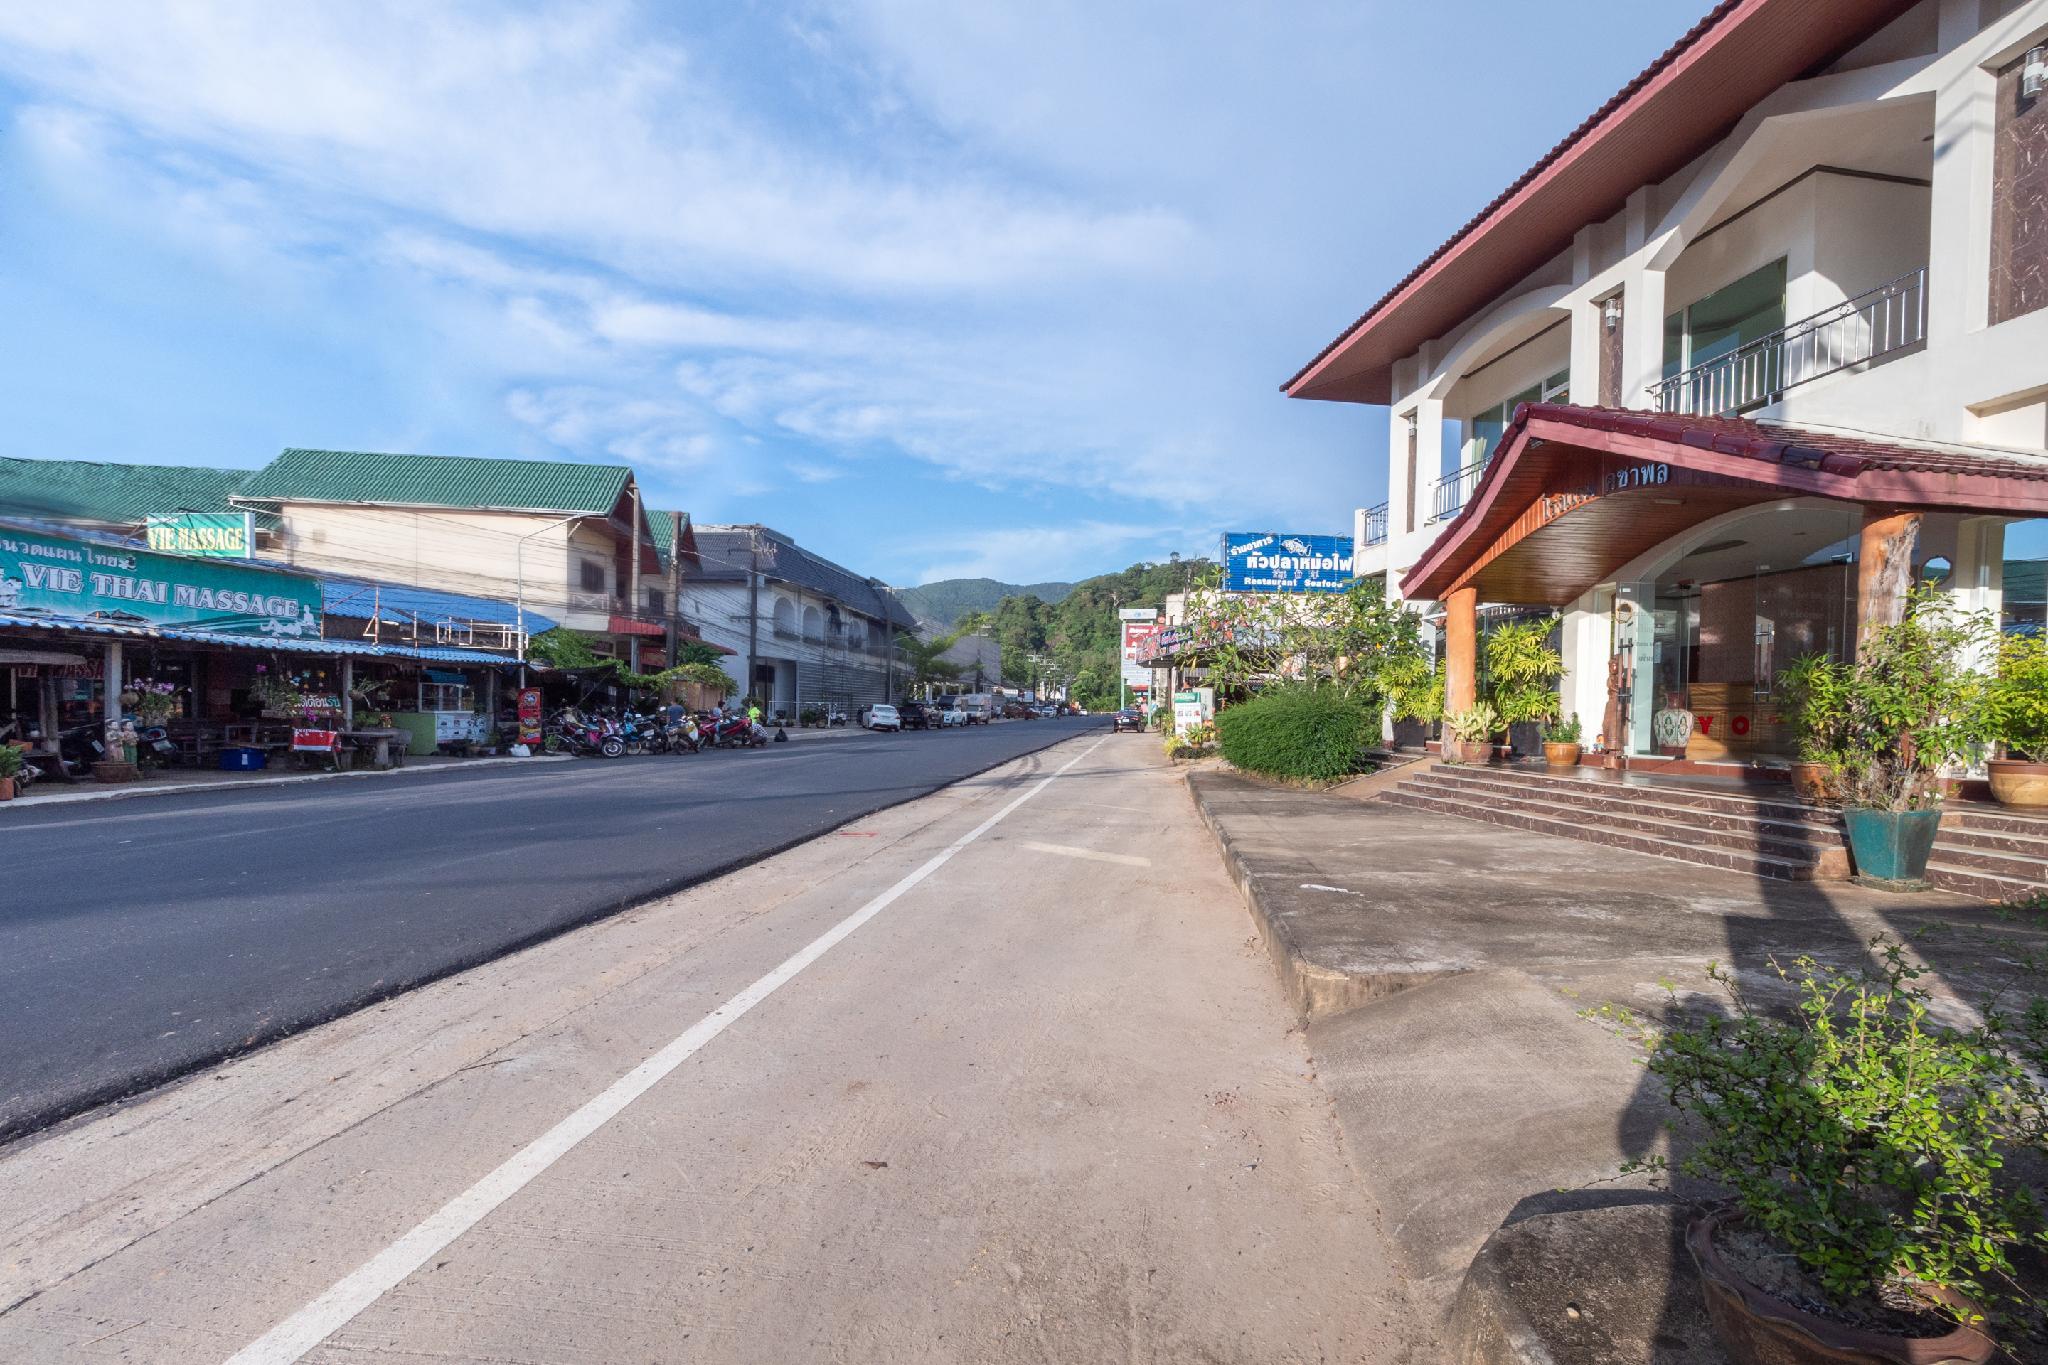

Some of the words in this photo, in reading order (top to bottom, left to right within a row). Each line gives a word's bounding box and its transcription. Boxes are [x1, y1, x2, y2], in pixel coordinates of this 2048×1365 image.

[148, 527, 176, 550] VIE
[178, 527, 244, 550] MASSAGE
[1231, 536, 1273, 556] ร้านอาหาร
[19, 562, 83, 594] VIE
[90, 571, 169, 605] THAI
[174, 583, 300, 618] MASSAGE
[1244, 577, 1297, 587] Restaurant
[1304, 579, 1343, 588] Seafood
[1698, 715, 1750, 735] YO
